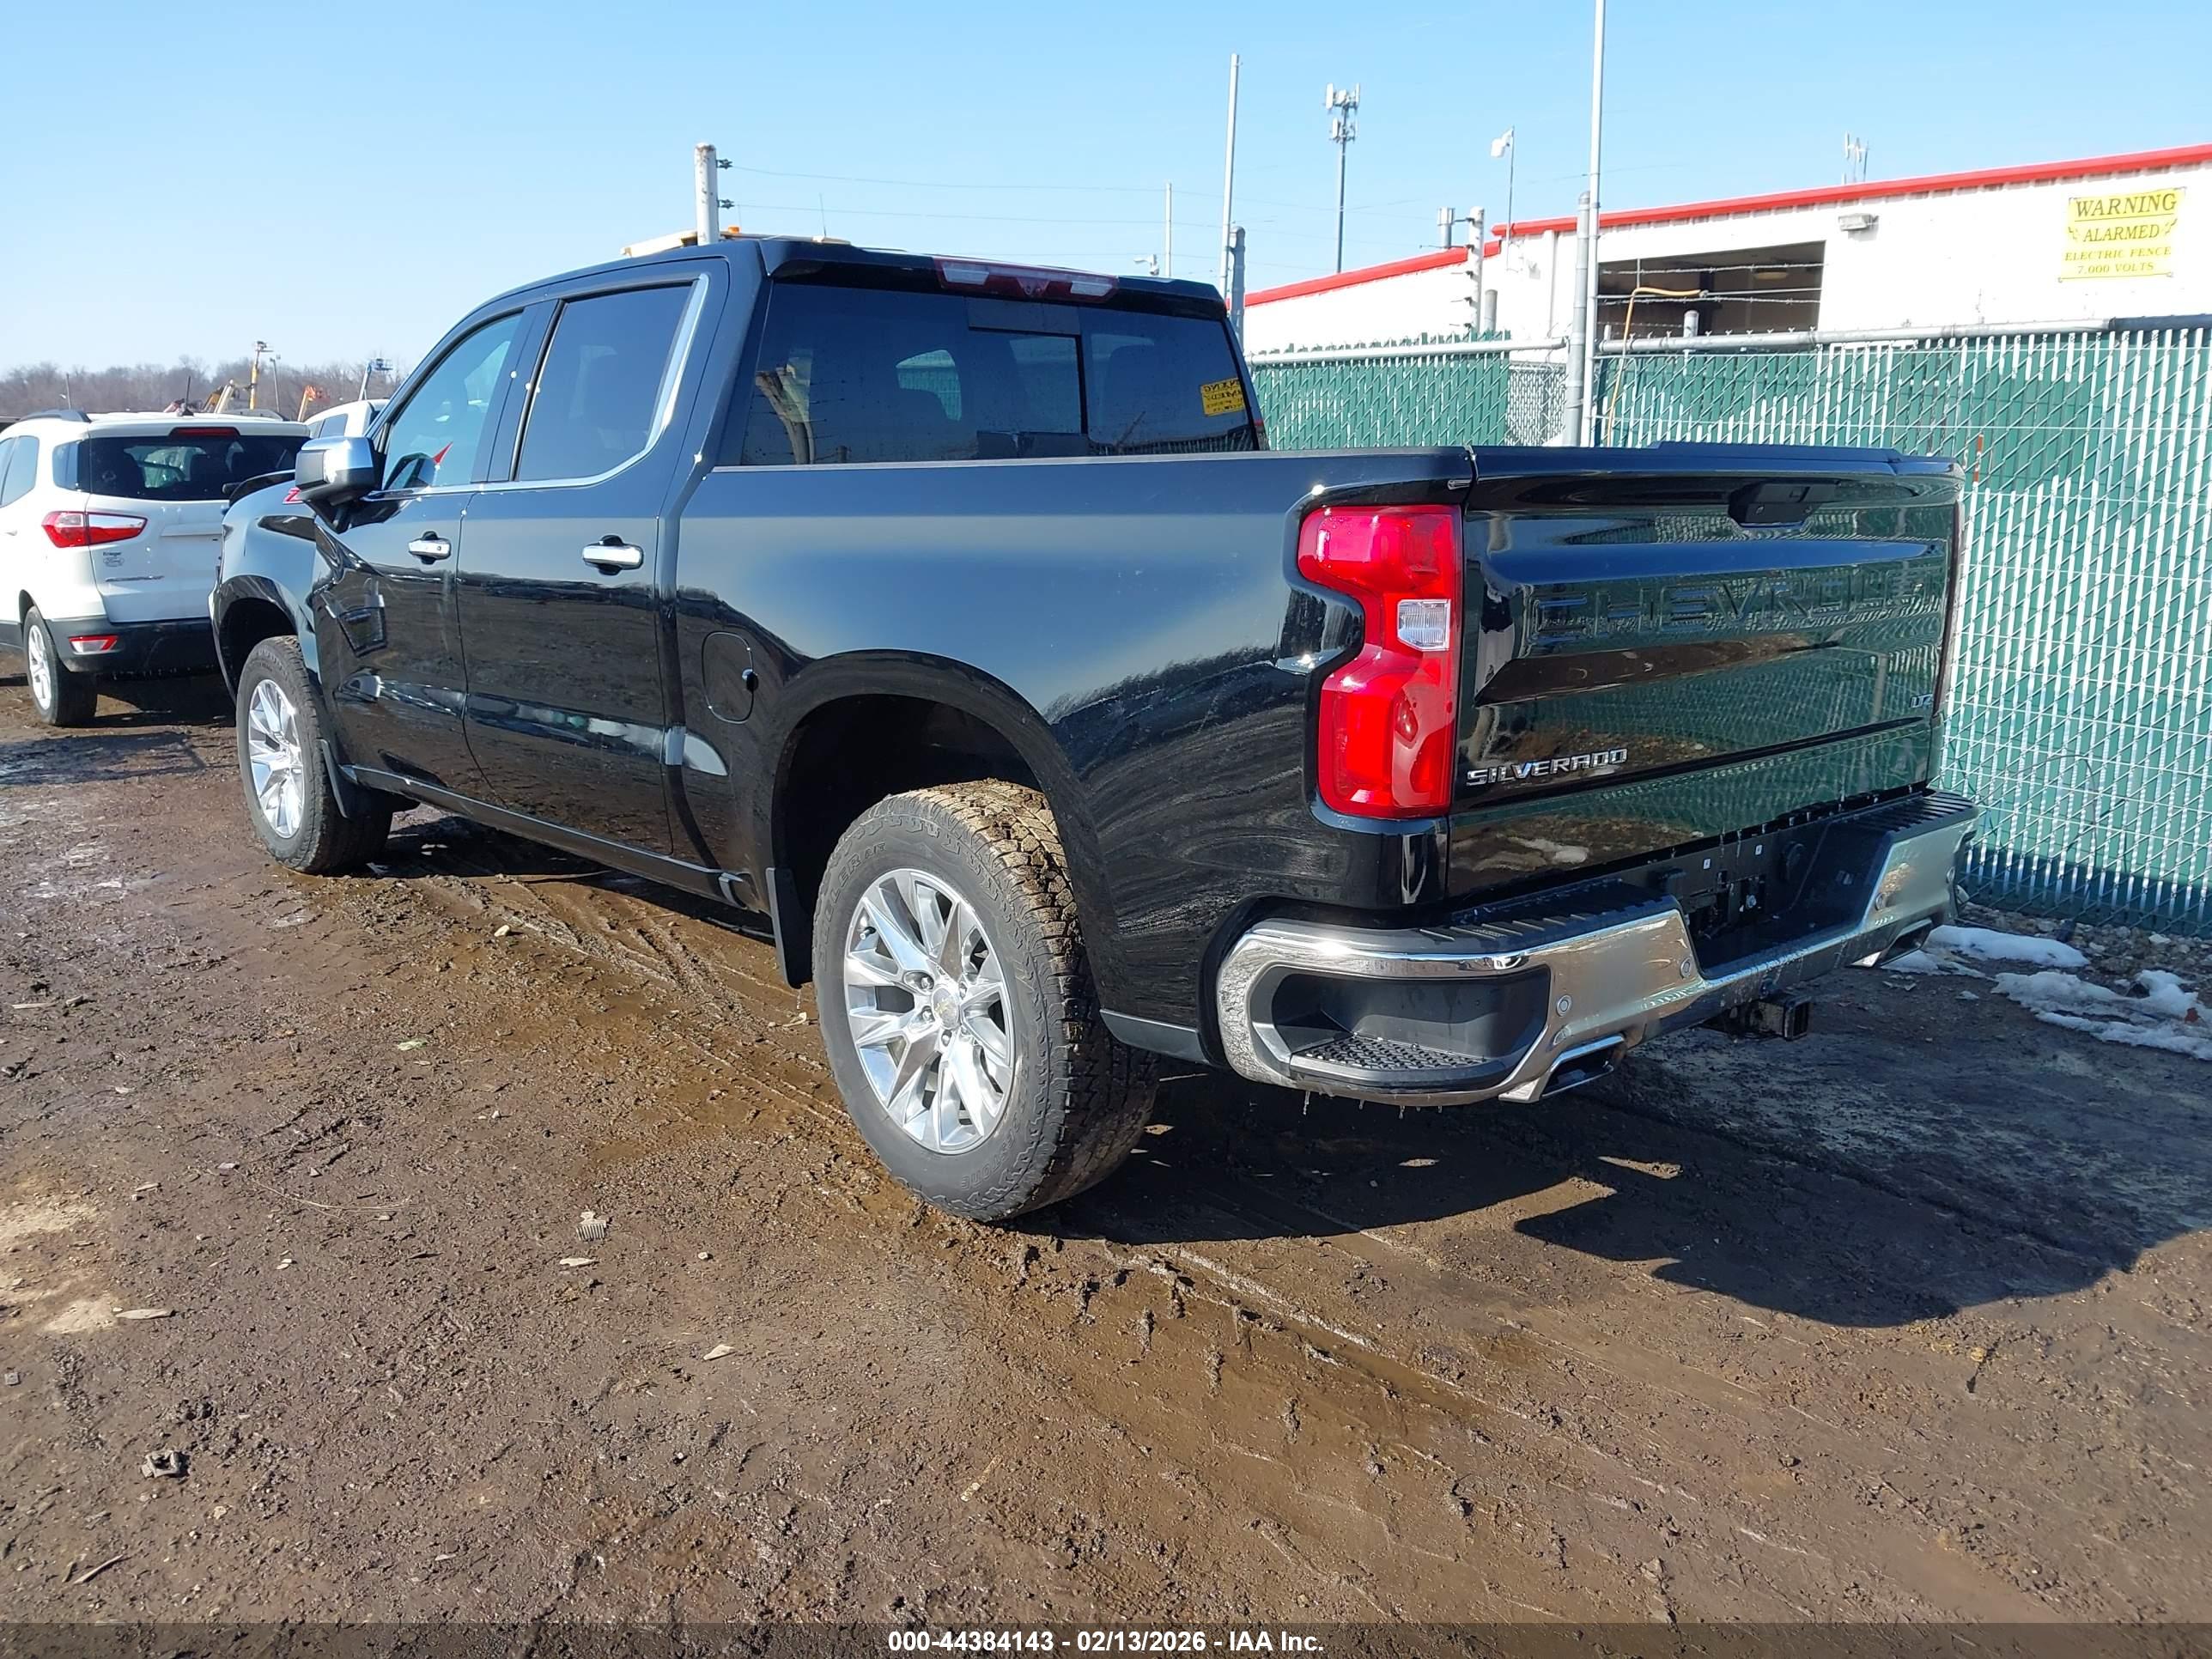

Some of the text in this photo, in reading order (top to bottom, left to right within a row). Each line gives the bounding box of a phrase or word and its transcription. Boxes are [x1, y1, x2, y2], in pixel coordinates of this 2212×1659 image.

[2075, 192, 2177, 217] WARNING
[2082, 223, 2160, 242] ALARMED
[2064, 246, 2172, 262] ELECTRIC FENCE
[2115, 261, 2154, 273] VOLTS
[1528, 562, 1939, 643] CHEVROLET
[1466, 748, 1628, 787] SILVERADO
